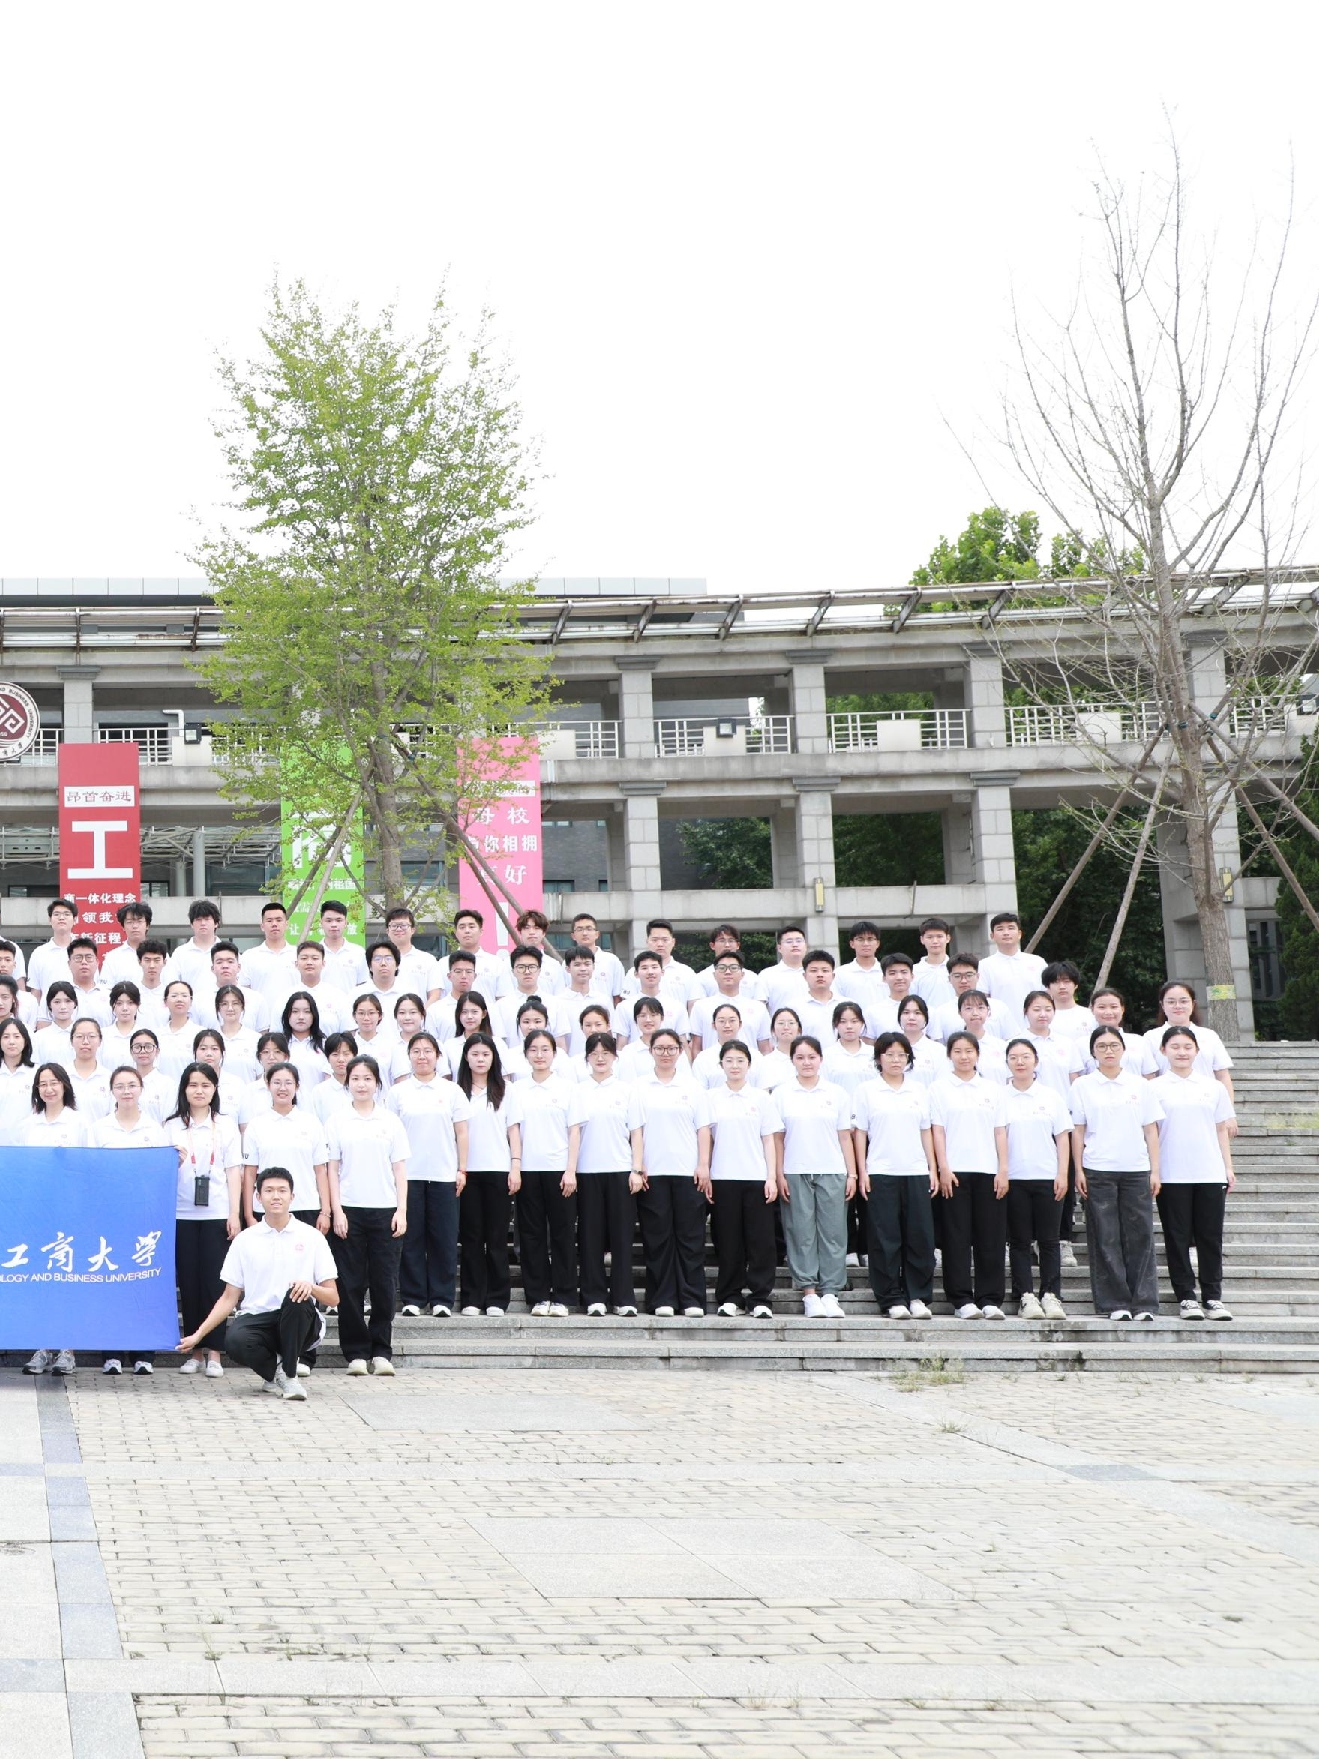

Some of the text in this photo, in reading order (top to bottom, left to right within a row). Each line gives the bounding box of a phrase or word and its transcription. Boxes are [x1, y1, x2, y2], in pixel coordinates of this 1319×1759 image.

[67, 790, 132, 803] 昂首奋进
[471, 807, 530, 825] 母校
[67, 820, 134, 879] 工
[30, 1273, 53, 1282] AND
[53, 1272, 104, 1283] BUSINESS
[105, 1267, 162, 1283] UNIVERSITY
